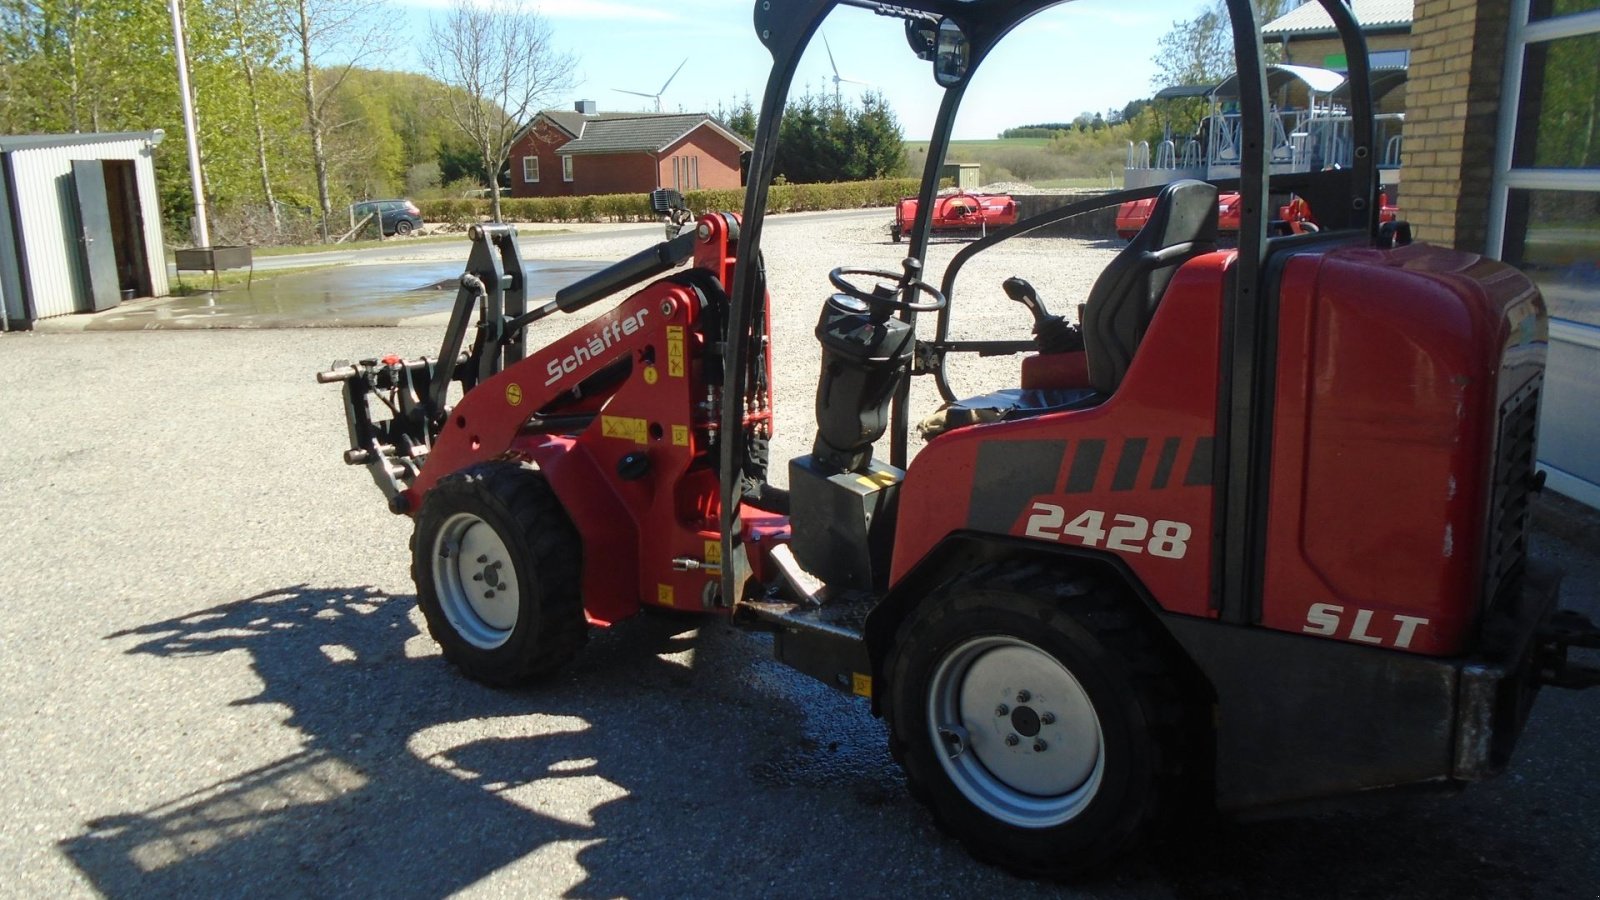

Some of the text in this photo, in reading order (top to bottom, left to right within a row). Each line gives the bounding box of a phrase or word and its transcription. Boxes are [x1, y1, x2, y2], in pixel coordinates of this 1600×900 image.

[545, 308, 649, 387] Schäffer
[1025, 502, 1192, 559] 2428
[1303, 602, 1430, 648] SLT
